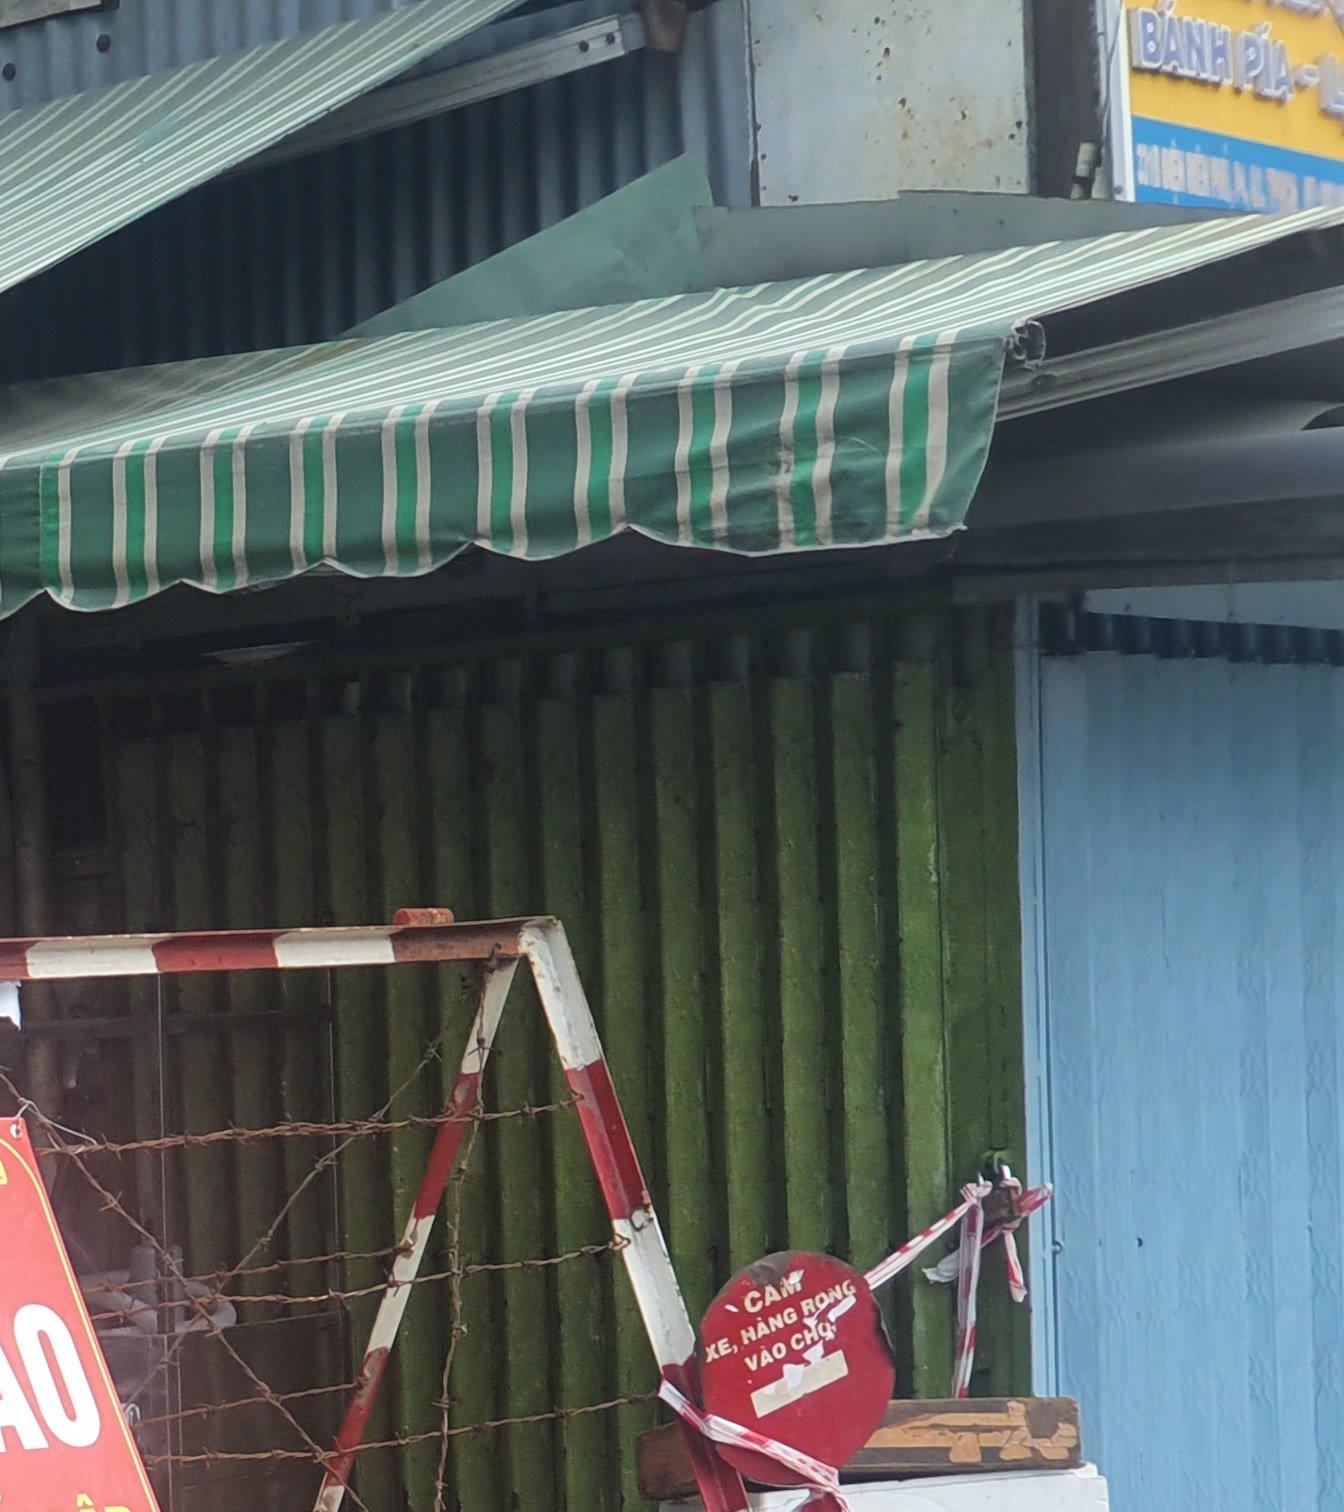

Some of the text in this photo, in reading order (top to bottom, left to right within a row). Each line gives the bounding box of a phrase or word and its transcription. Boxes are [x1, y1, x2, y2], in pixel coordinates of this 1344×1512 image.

[1130, 0, 1232, 84] BÁNH
[1233, 21, 1295, 101] PÍA
[705, 1337, 739, 1363] XE,
[740, 1306, 798, 1345] HÀNG
[744, 1341, 787, 1371] VÀO
